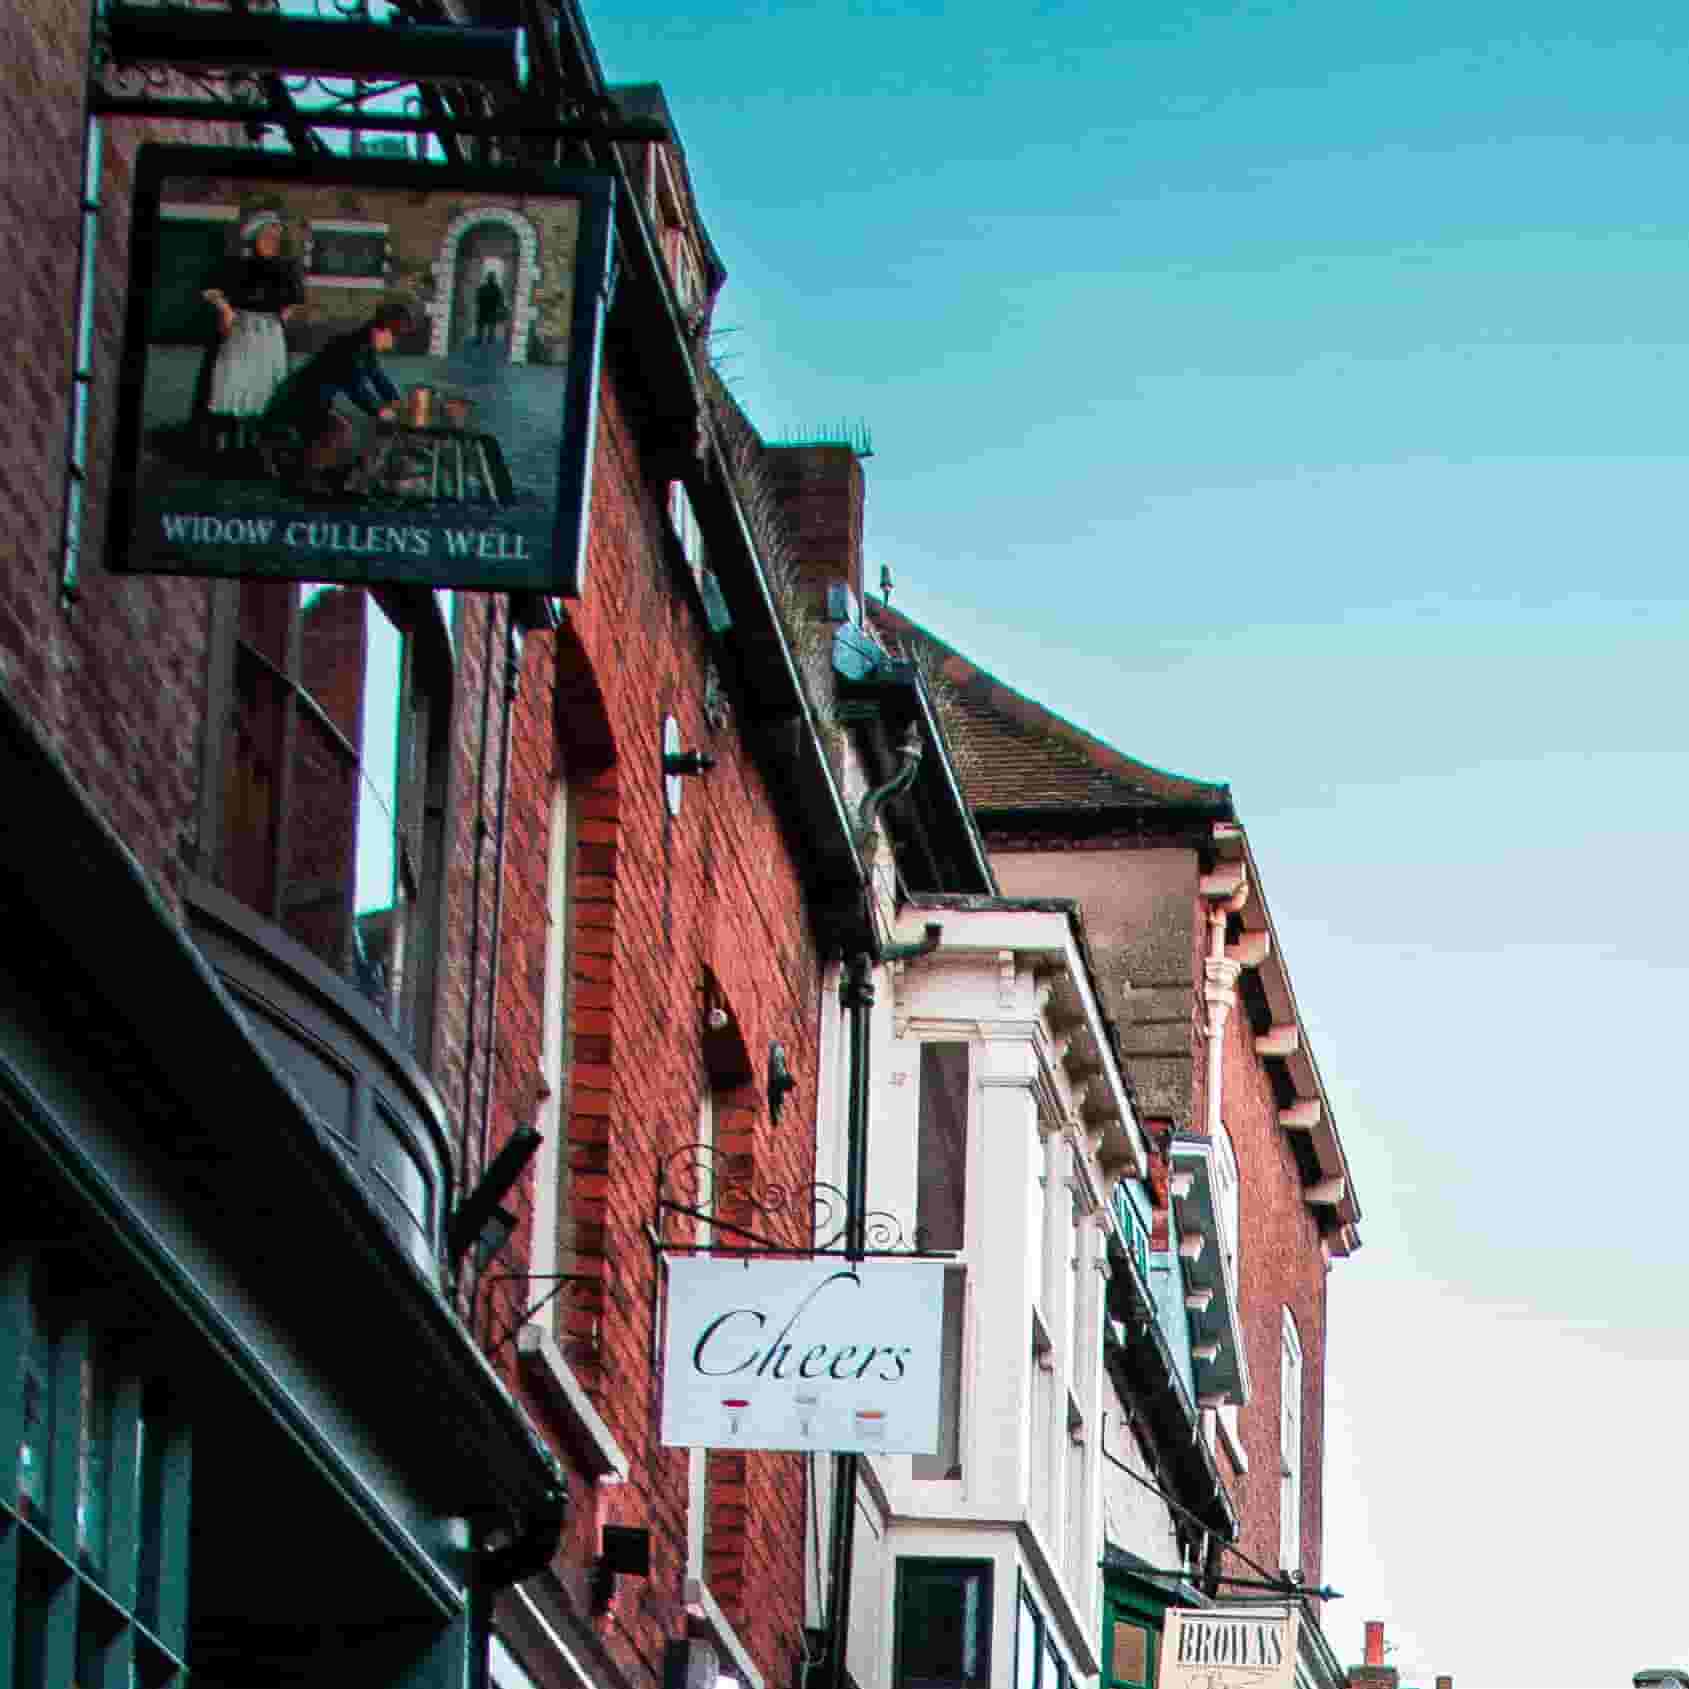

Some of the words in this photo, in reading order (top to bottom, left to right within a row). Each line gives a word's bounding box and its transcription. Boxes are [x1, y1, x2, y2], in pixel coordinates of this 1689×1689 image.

[160, 512, 274, 546] WIDOW
[283, 519, 432, 557] CULLEN'S
[442, 527, 530, 561] WELL
[692, 1270, 912, 1382] Cheers
[1177, 1622, 1281, 1666] BROWNS
